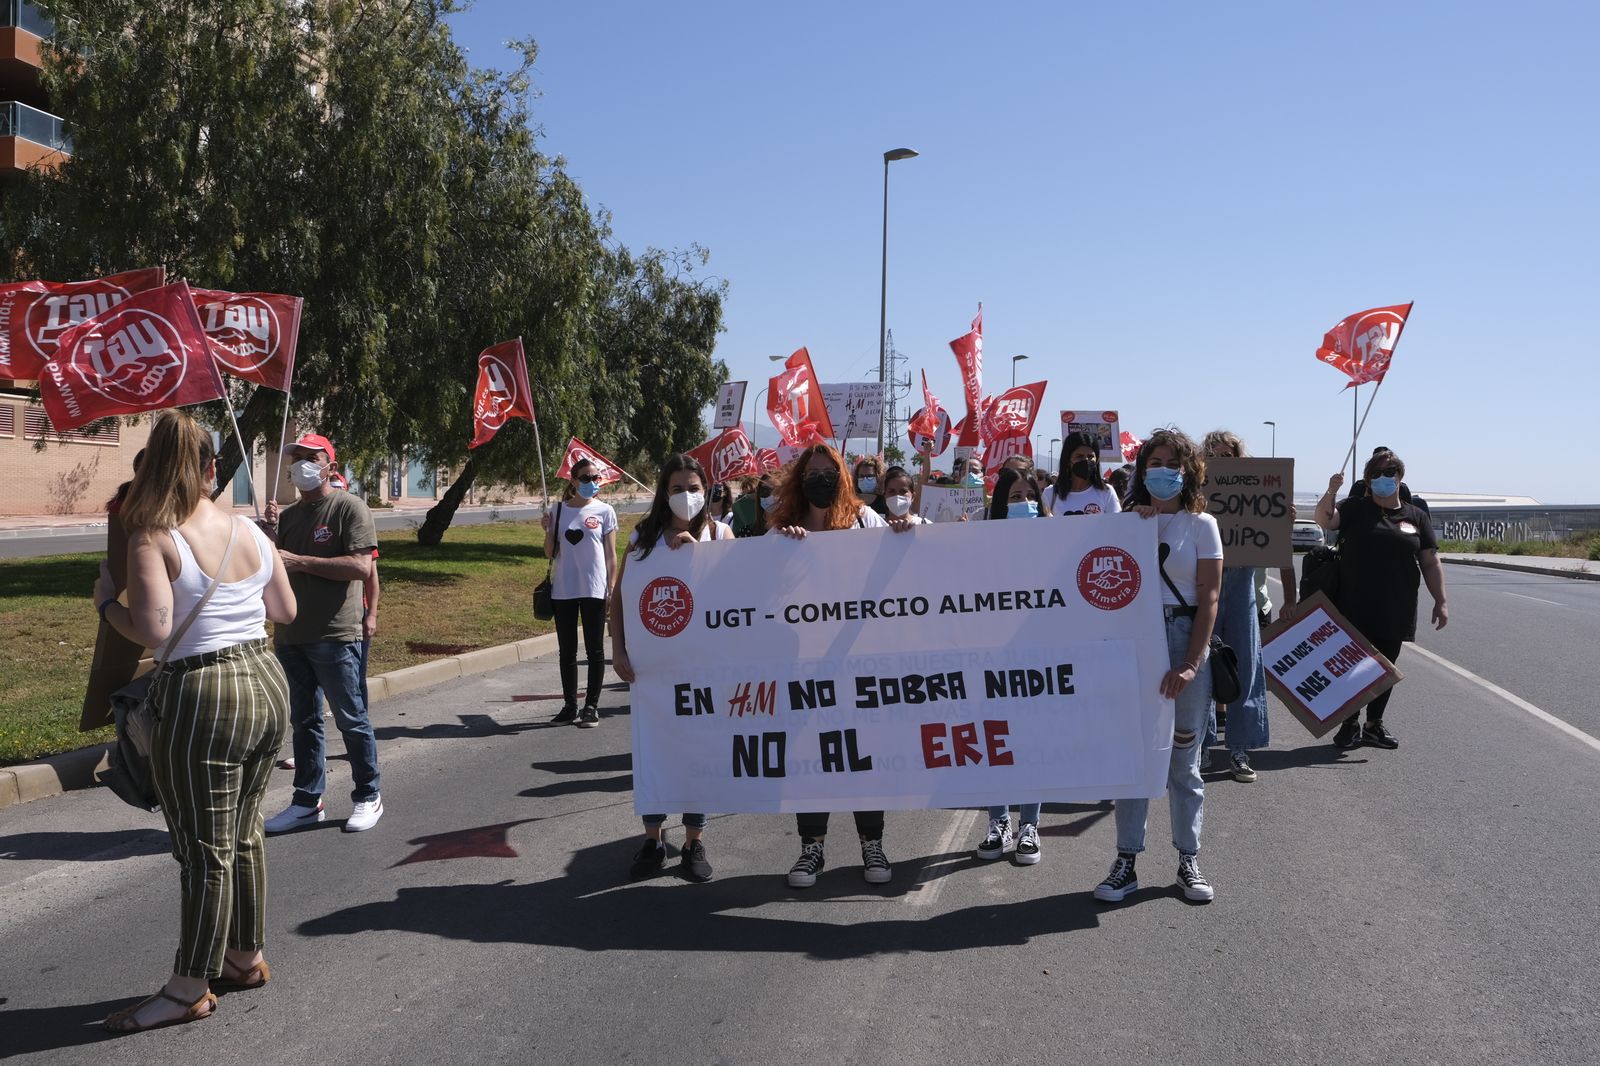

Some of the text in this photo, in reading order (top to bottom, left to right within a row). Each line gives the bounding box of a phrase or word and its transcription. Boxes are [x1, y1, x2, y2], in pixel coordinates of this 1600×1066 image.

[986, 436, 1026, 469] UGT
[1214, 475, 1261, 487] VALORES
[1262, 474, 1282, 488] HM
[1209, 492, 1288, 518] SOMOS
[1221, 523, 1270, 548] UiPO
[1442, 521, 1477, 541] LEROY
[1092, 556, 1124, 573] UGT
[653, 585, 680, 602] UGT
[706, 608, 756, 629] UGT
[784, 597, 929, 624] COMERCIO
[939, 589, 1066, 613] ALMERIA
[1271, 620, 1340, 677] NO NOS VAMOS
[1295, 640, 1368, 702] NOS ECHAN
[674, 664, 1074, 718] EN H&M NO SOBRA NADIE
[733, 719, 1015, 778] NO AL ERE
